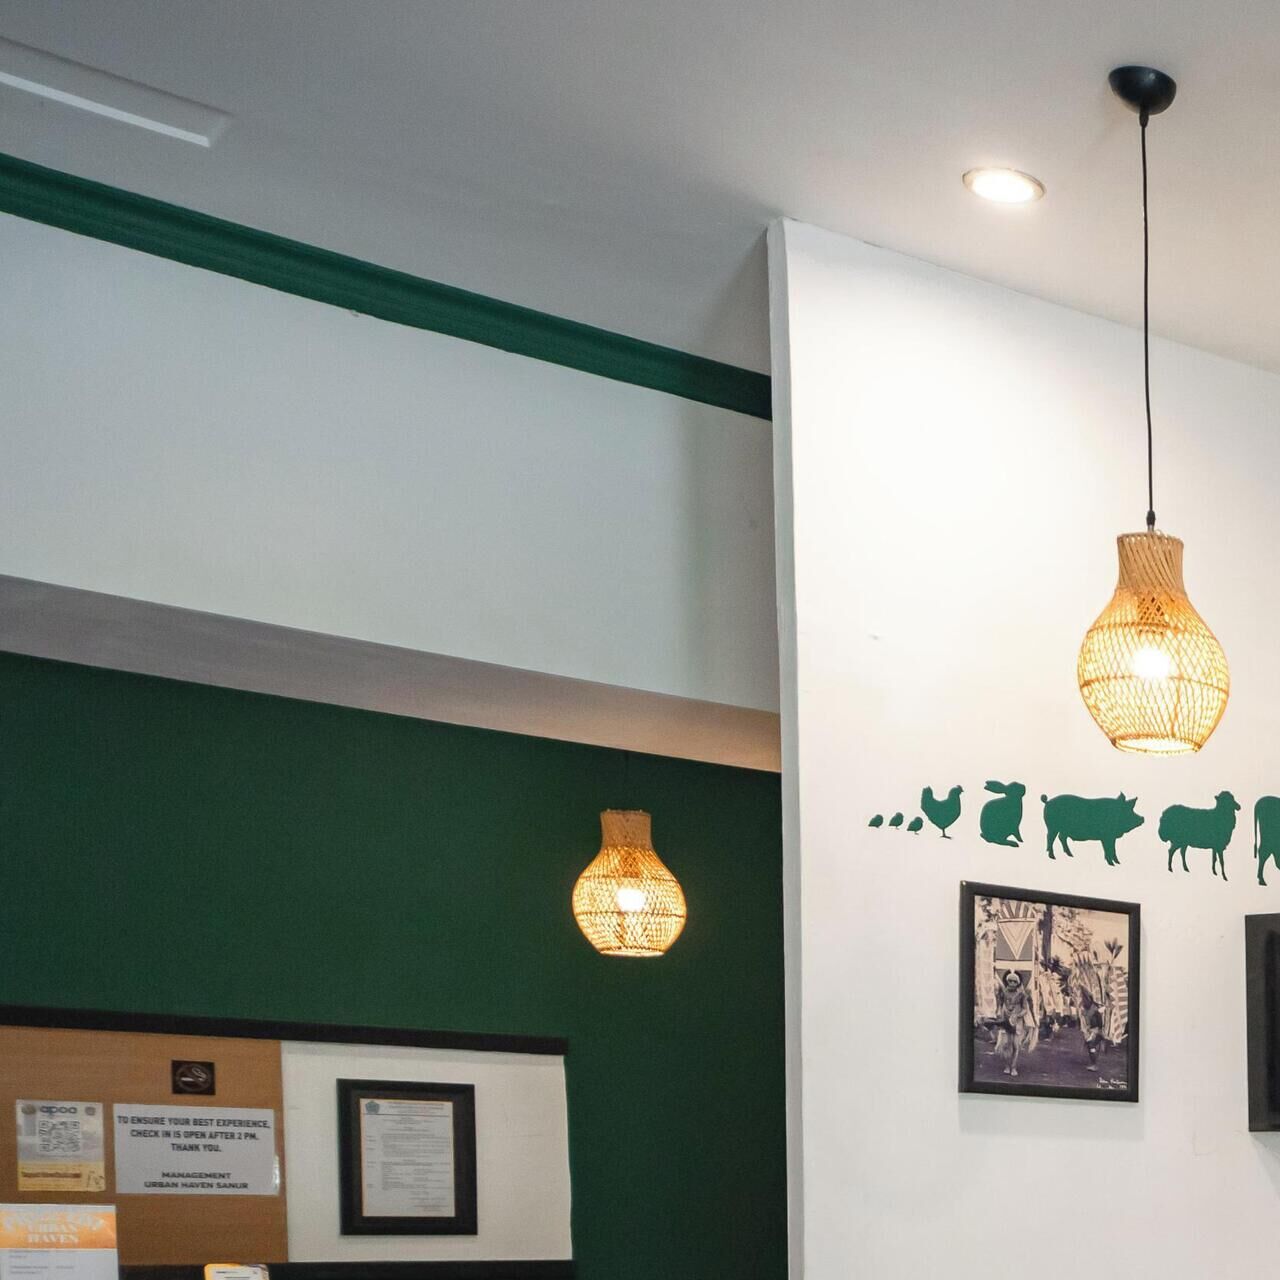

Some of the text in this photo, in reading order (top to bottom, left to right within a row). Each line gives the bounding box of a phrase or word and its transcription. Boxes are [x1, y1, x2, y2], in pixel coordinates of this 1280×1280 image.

[117, 1115, 271, 1129] TO ENSURE YOUR BEST EXPERIENCE,
[130, 1129, 259, 1141] CHECK IN IS OPEN AFTER 2 PM.
[171, 1143, 223, 1153] THANK YOU.
[162, 1171, 232, 1179] MANAGEMENT
[181, 1181, 214, 1189] HAVEN
[216, 1182, 249, 1190] SANUR
